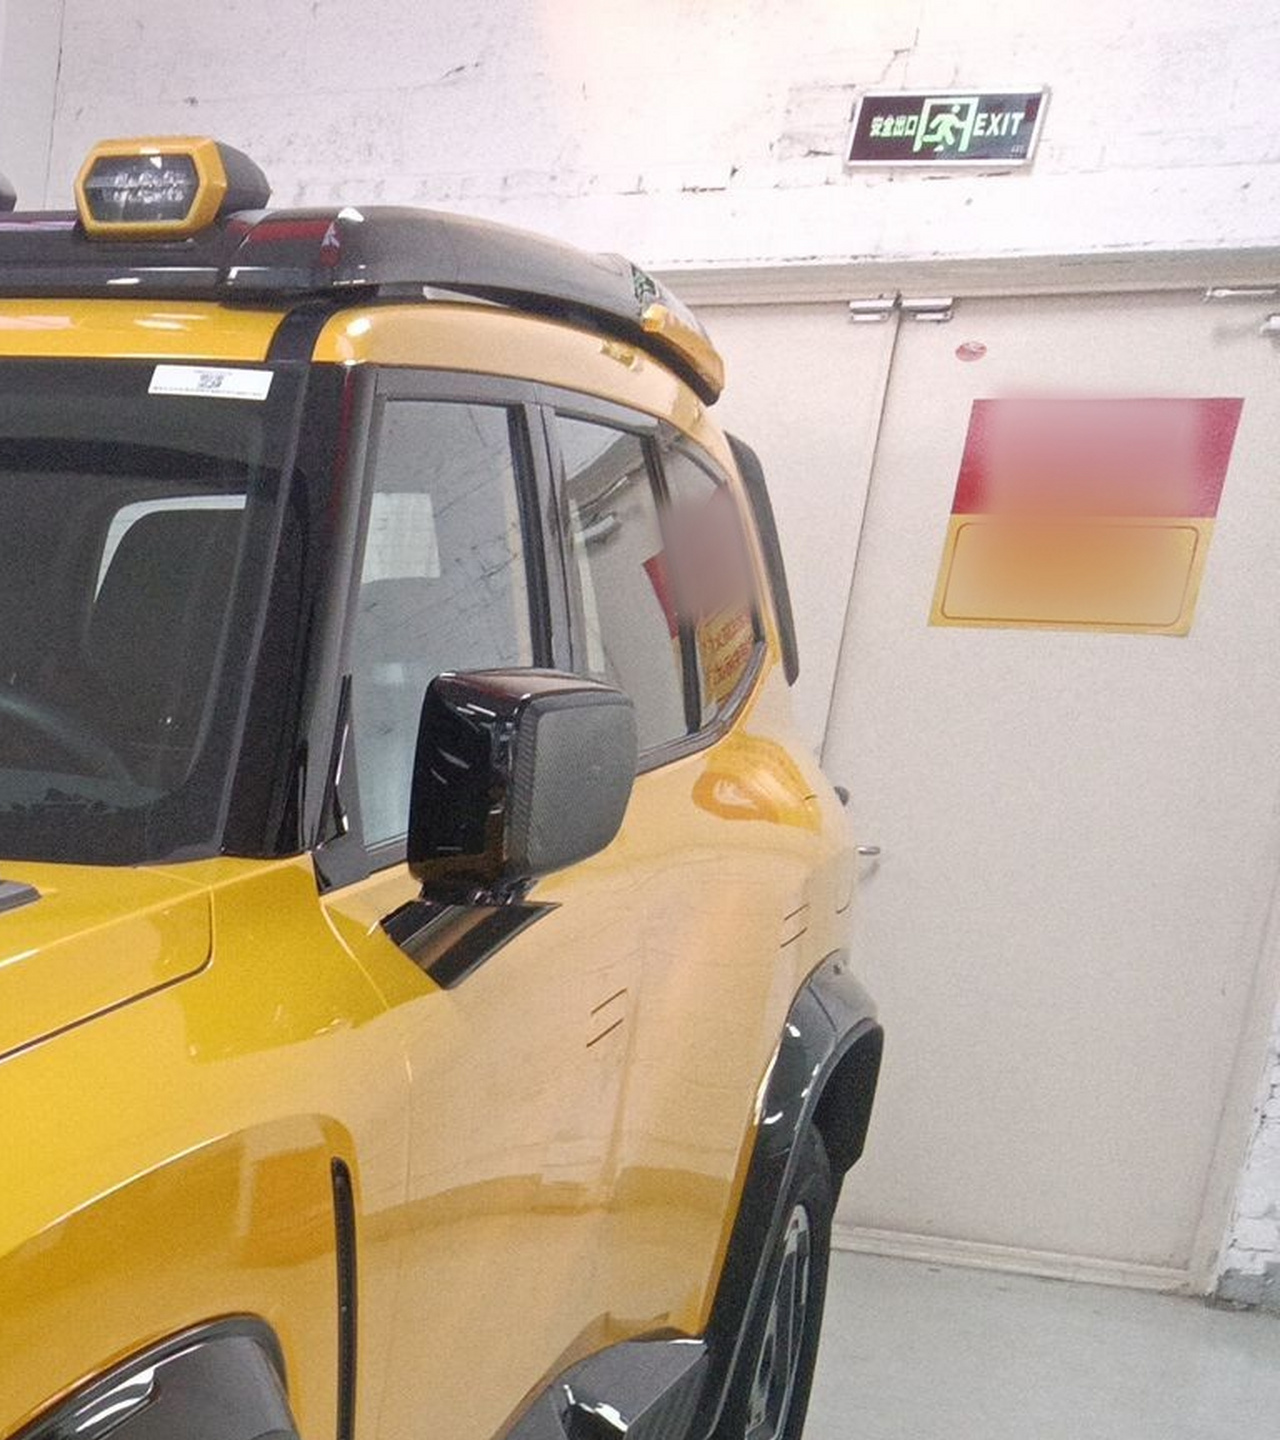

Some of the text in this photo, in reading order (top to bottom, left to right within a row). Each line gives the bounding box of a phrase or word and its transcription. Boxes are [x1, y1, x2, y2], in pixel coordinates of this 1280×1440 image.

[869, 114, 920, 138] 安全出口
[973, 111, 1025, 137] EXIT
